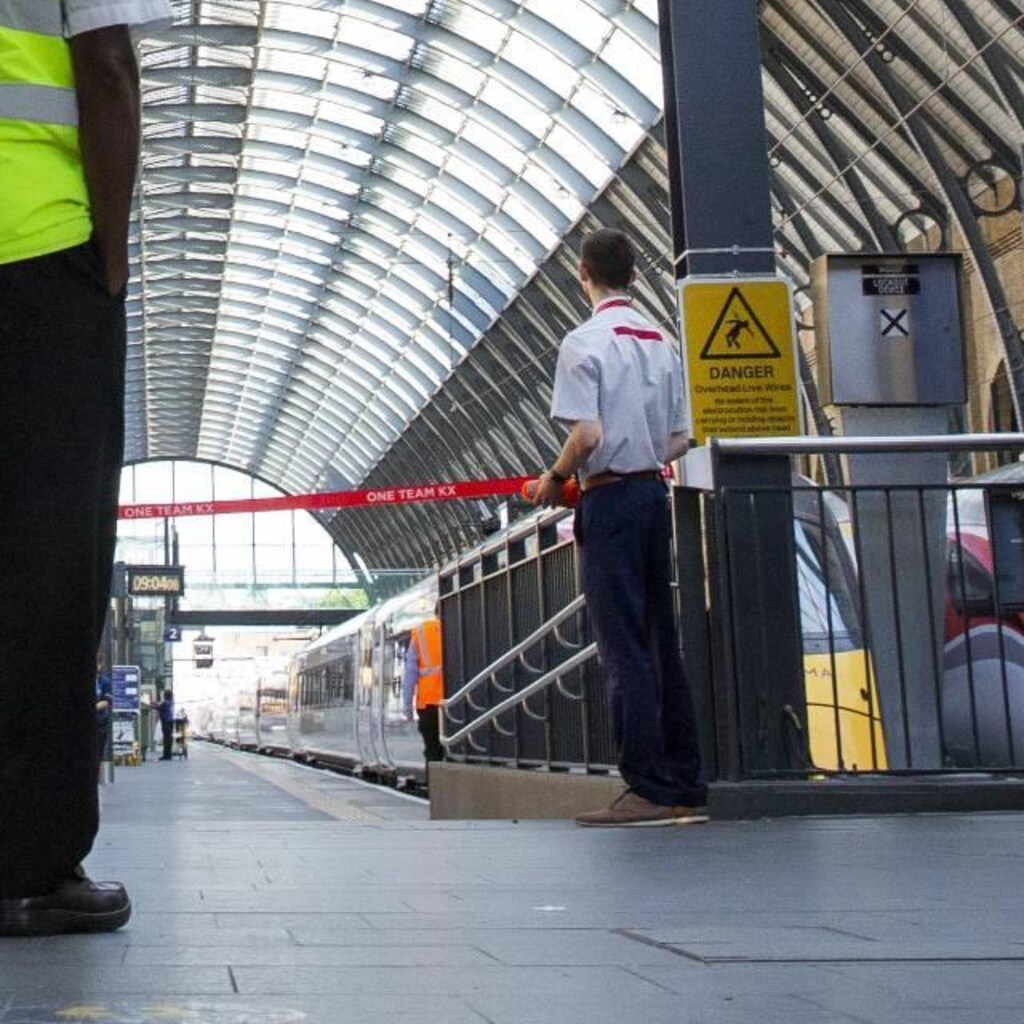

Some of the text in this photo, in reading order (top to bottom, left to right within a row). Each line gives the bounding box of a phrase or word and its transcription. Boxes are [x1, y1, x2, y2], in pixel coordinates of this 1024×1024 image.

[709, 365, 775, 380] DANGER
[695, 384, 740, 393] Overhead
[366, 484, 457, 502] ONE TEAM KX
[124, 503, 215, 517] ONE TEAM KX
[169, 628, 178, 639] 2
